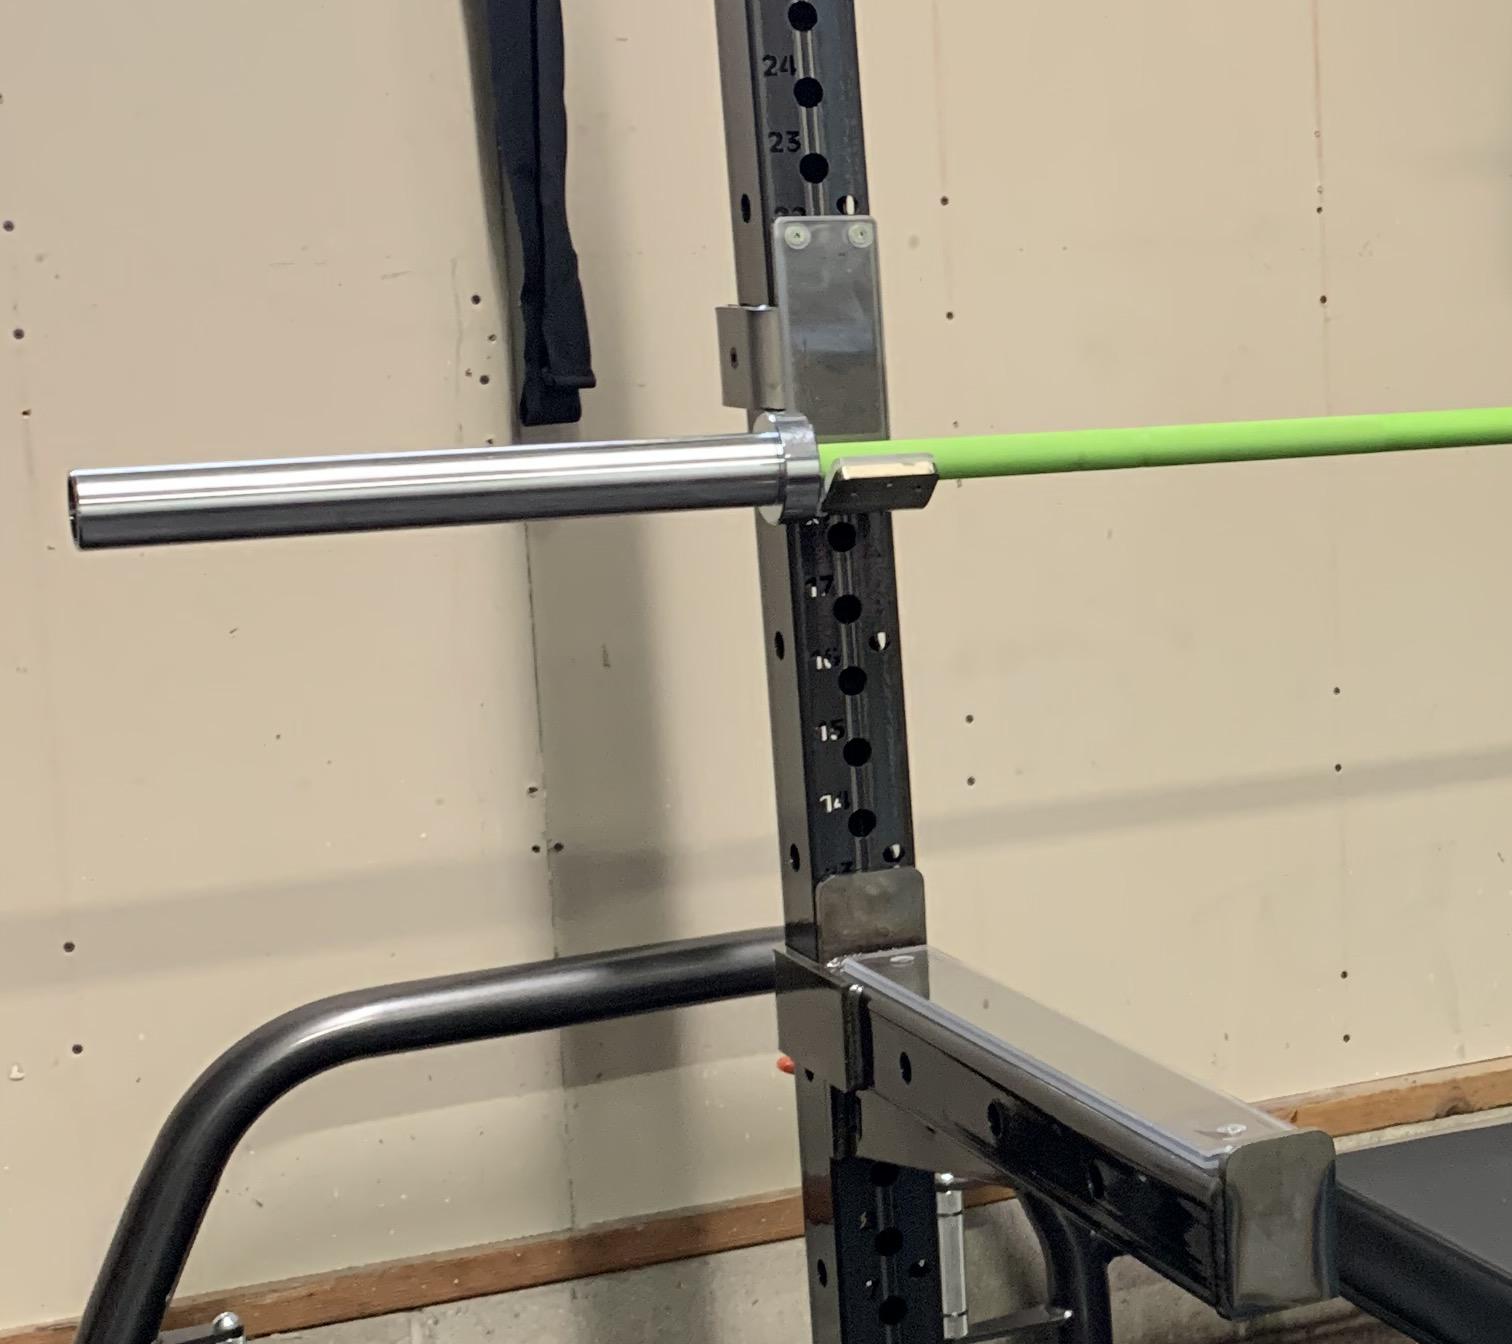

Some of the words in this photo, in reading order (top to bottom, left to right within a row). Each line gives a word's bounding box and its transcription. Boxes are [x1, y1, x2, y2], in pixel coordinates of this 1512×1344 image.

[762, 54, 797, 77] 24
[768, 130, 802, 153] 23
[805, 574, 835, 598] 17
[816, 718, 846, 742] 15
